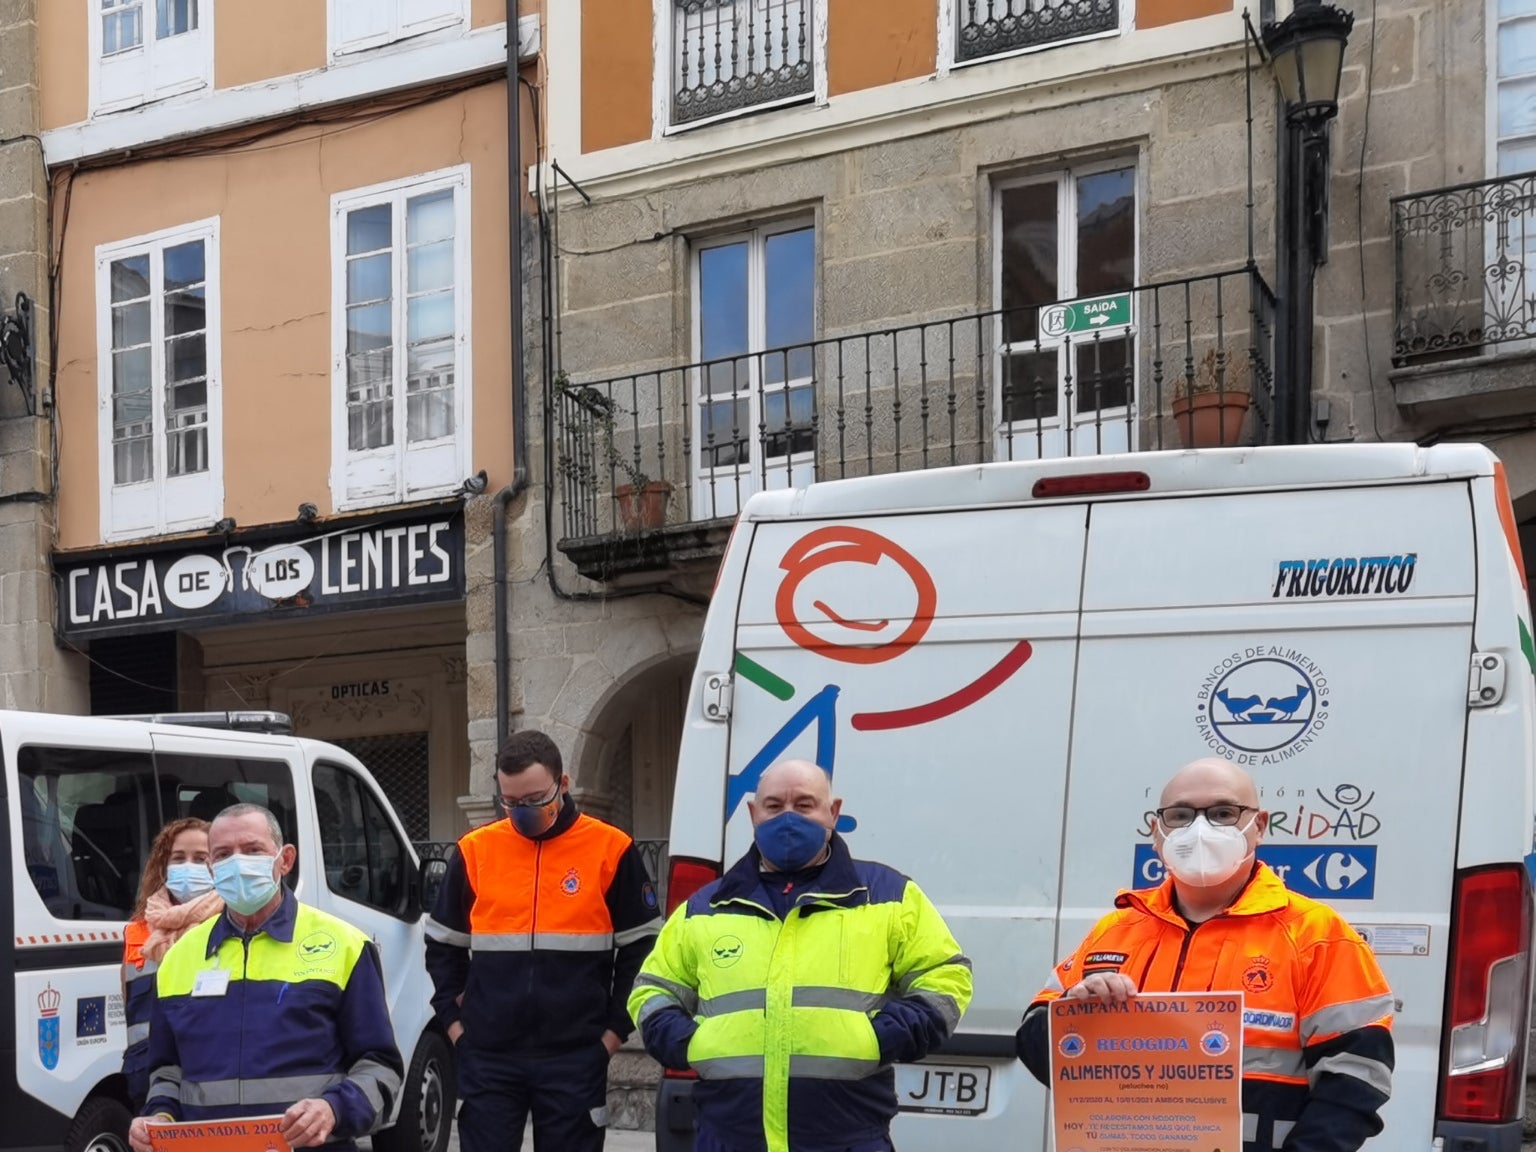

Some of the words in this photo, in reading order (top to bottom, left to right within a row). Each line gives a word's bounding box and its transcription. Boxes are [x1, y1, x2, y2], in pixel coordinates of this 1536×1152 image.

[70, 559, 162, 624] CASA
[179, 570, 210, 593] DE
[265, 558, 300, 582] LOS
[322, 522, 450, 595] LENTES
[1273, 555, 1415, 597] FRIGORIFICO
[1197, 653, 1242, 699] BANCOS
[1245, 646, 1264, 658] DE
[1268, 646, 1329, 696] ALIMENTOS
[331, 680, 389, 700] OPTICAS
[1196, 715, 1235, 760] BANCOS
[1238, 754, 1258, 765] DE
[1262, 712, 1328, 765] ALIMENTOS
[1134, 1001, 1189, 1014] NADAL
[1195, 1001, 1237, 1013] 2020
[1096, 1038, 1190, 1051] RECOGIDA
[1060, 1064, 1141, 1081] ALIMENTOS
[1144, 1064, 1154, 1080] Y
[1159, 1064, 1234, 1080] JUGUETES
[909, 1071, 977, 1102] JTB
[208, 1124, 249, 1136] NADAL
